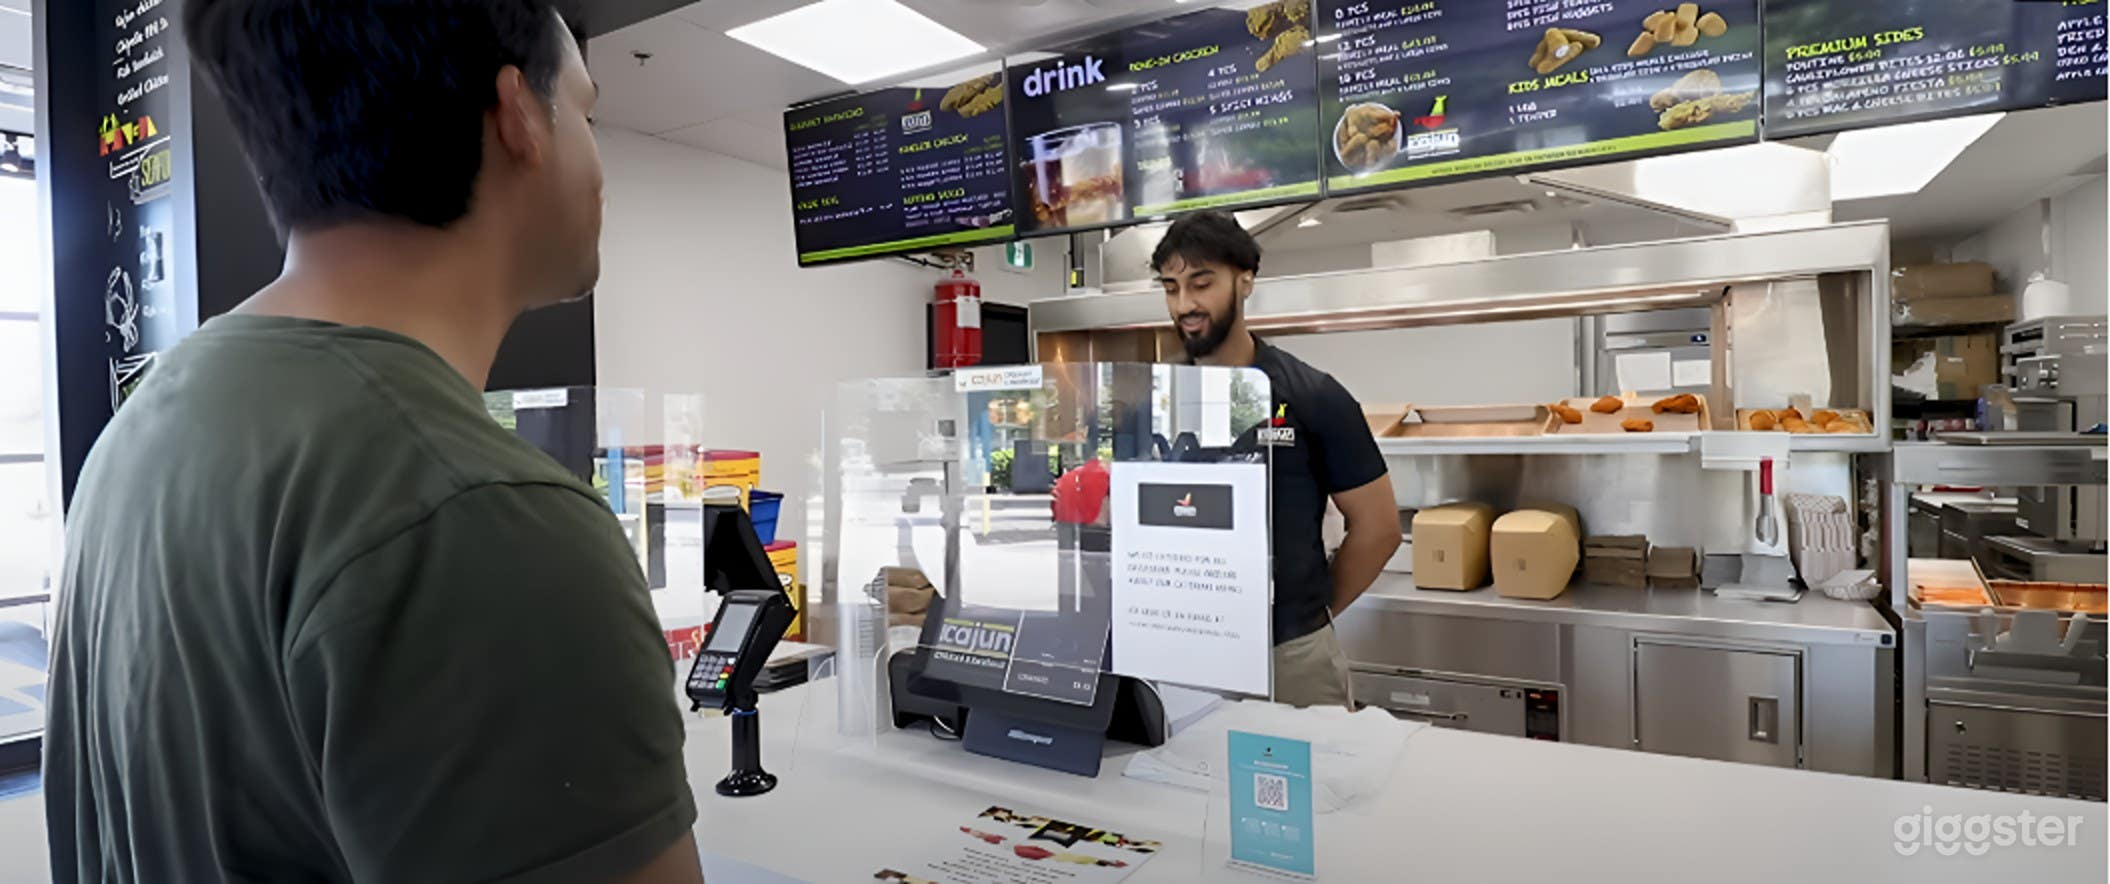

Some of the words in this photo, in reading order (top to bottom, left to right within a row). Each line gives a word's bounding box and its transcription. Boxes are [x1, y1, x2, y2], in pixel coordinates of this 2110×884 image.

[1785, 35, 1868, 60] PREMIUM
[1873, 26, 1924, 46] SIDES
[1023, 56, 1105, 98] drink
[1947, 55, 1999, 73] STICKS
[941, 622, 1011, 652] cajun
